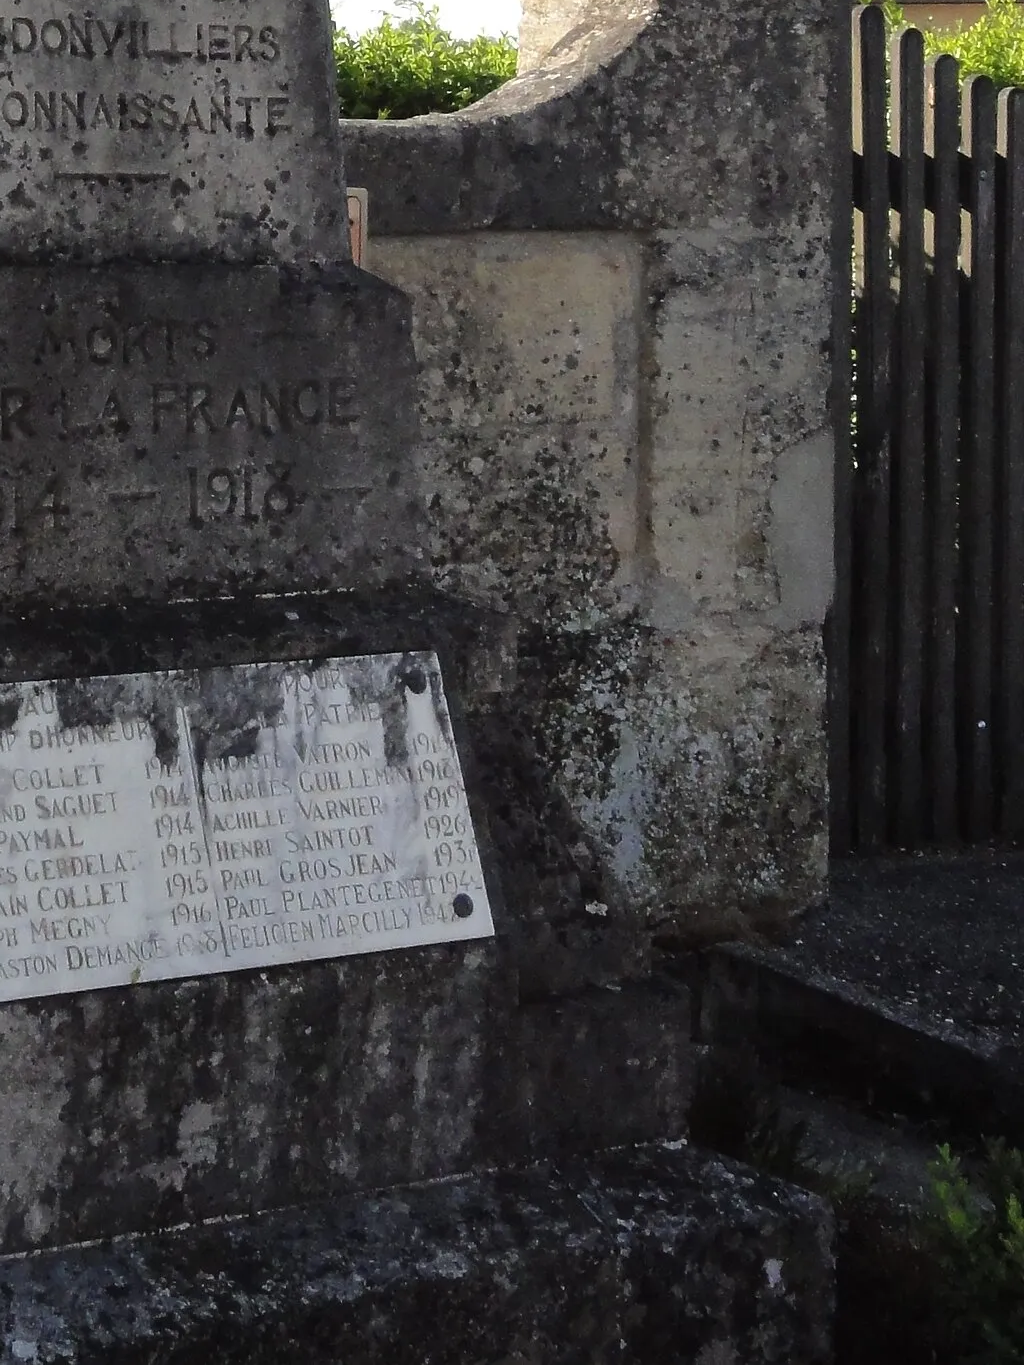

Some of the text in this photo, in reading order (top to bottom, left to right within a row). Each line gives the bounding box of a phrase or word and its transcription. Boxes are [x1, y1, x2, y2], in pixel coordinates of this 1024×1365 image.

[35, 320, 218, 366] MORTS
[56, 385, 133, 435] LA
[150, 377, 361, 437] FRANCE
[187, 461, 298, 531] 1918
[284, 669, 345, 694] POUR
[24, 690, 55, 715] AU
[303, 702, 383, 726] PATRIE
[293, 738, 372, 765] VATRON
[411, 731, 457, 756] 191
[12, 763, 105, 792] COLLET
[204, 778, 293, 804] CHARLES
[34, 791, 118, 820] SAGUET
[149, 782, 191, 808] 1914
[212, 784, 461, 832] ACHILLE VARNIER 1919
[154, 810, 195, 839] 1914
[214, 813, 467, 862] HENRI SAINTOT 1926
[160, 841, 202, 869] 1915
[220, 867, 271, 891] PAUL
[279, 851, 398, 883] GROSJEAN
[37, 880, 130, 911] COLLET
[165, 868, 208, 899] 1915
[225, 894, 276, 920] PAUL
[281, 874, 436, 913] PLANTEGENET
[29, 913, 112, 944] MEGNY
[170, 901, 213, 928] 1916
[228, 921, 316, 951] FELICIEN
[64, 936, 170, 971] DEMANGE
